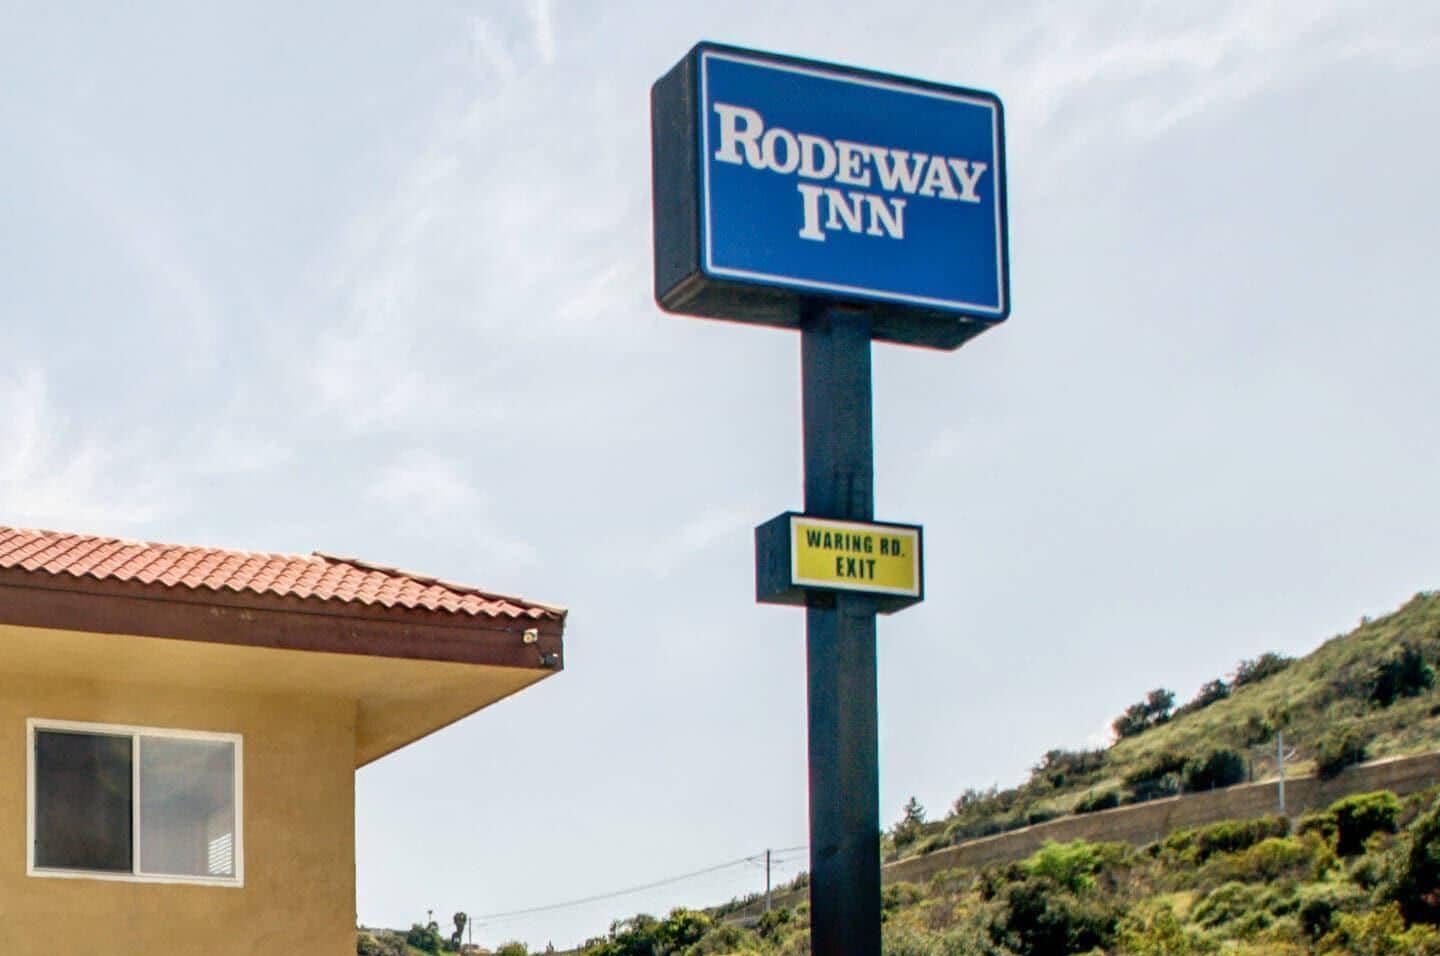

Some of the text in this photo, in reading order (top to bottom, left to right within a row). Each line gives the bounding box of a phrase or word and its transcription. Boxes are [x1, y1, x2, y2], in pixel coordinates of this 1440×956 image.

[714, 103, 986, 202] RODEWAY
[798, 183, 906, 241] INN
[807, 530, 905, 557] WARING RD.
[836, 556, 876, 579] EXIT
